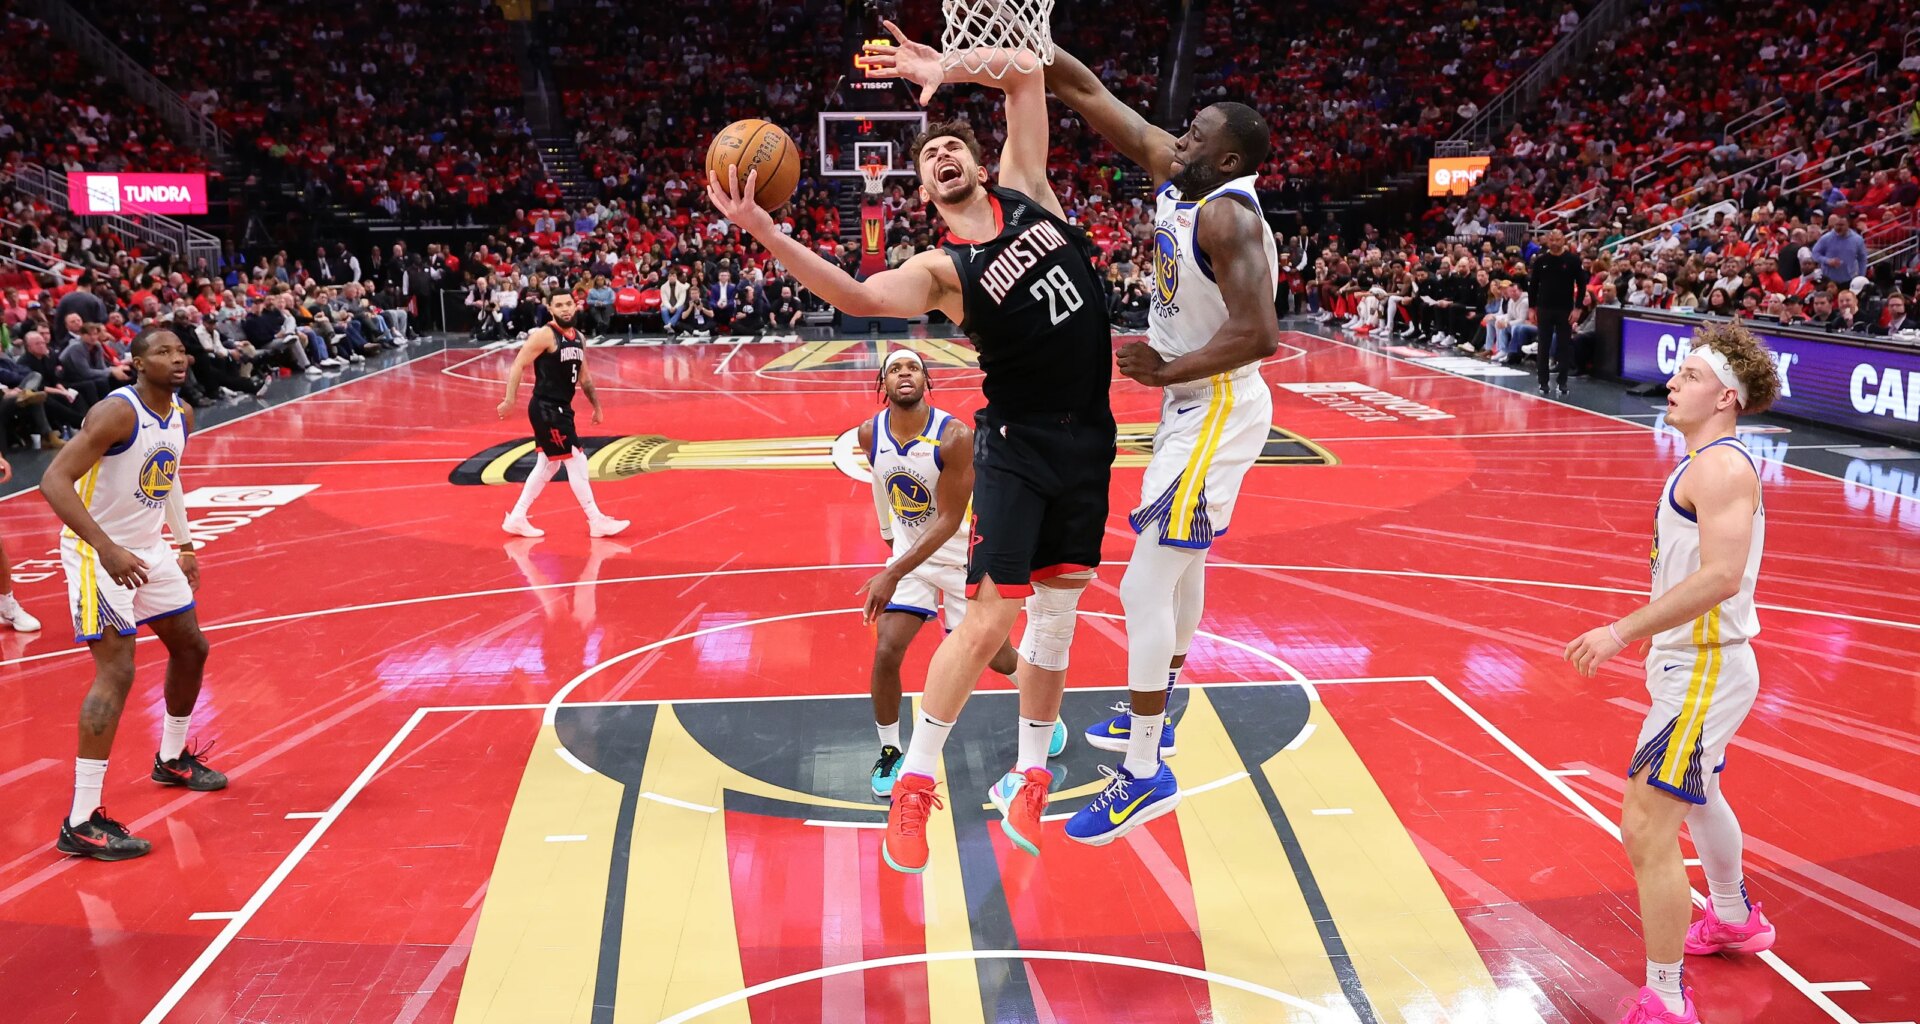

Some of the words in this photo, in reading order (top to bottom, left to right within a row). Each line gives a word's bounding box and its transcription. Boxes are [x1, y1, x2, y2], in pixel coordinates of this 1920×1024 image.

[123, 185, 192, 203] TUNDRA
[979, 219, 1068, 306] HOUSTON
[1162, 253, 1175, 279] 23
[1029, 265, 1084, 326] 28
[560, 346, 584, 363] HOUSTO
[571, 363, 578, 384] 5
[1303, 393, 1399, 422] CENTER
[1350, 391, 1457, 421] TOYOTA
[143, 441, 166, 458] GOLDEN
[163, 460, 176, 475] 00
[882, 465, 906, 480] GOLDEN
[908, 468, 928, 484] STATE
[133, 488, 166, 509] WARRI
[910, 485, 919, 499] 7
